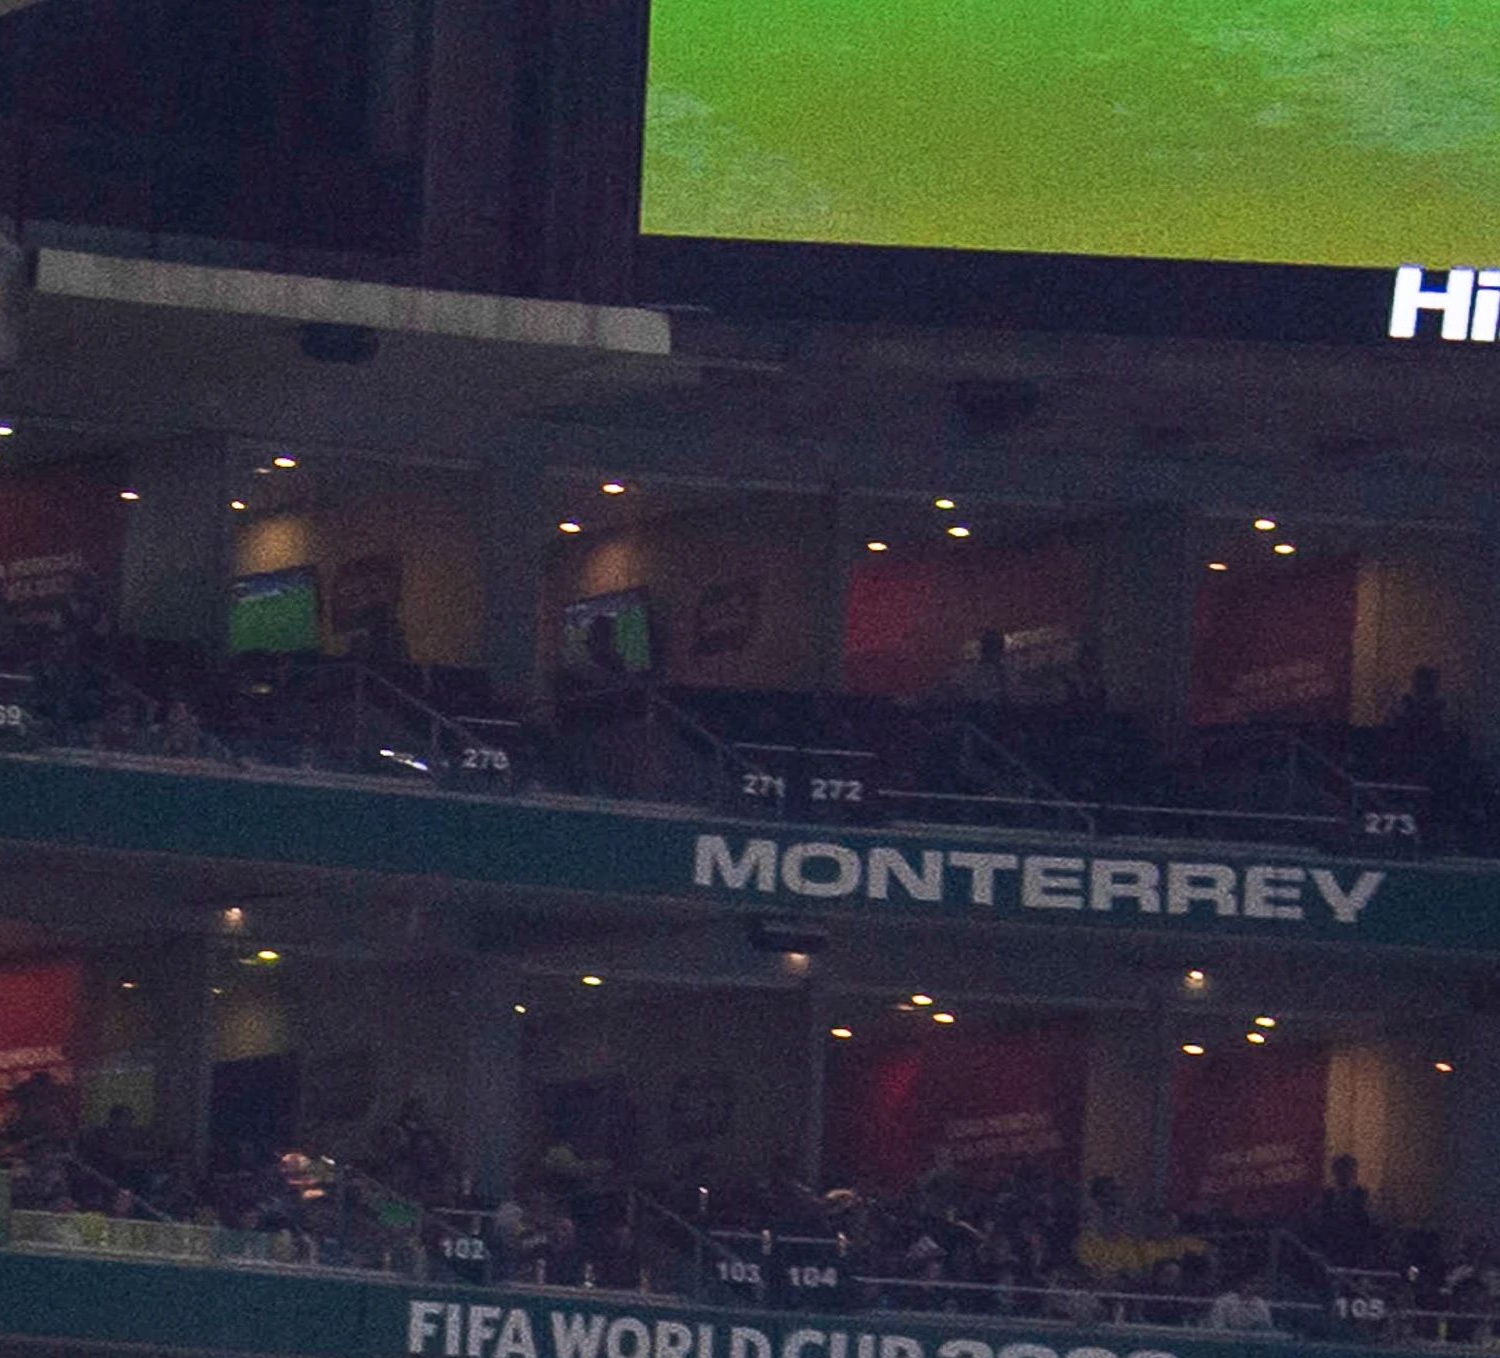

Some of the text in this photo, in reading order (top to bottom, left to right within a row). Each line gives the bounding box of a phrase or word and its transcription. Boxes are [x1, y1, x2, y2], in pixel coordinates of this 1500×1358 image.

[1386, 266, 1500, 342] Hi
[694, 833, 1386, 922] MONTERREY
[442, 1237, 485, 1261] 102
[716, 1260, 762, 1284] 103
[788, 1266, 838, 1288] 104
[1334, 1297, 1386, 1320] 105
